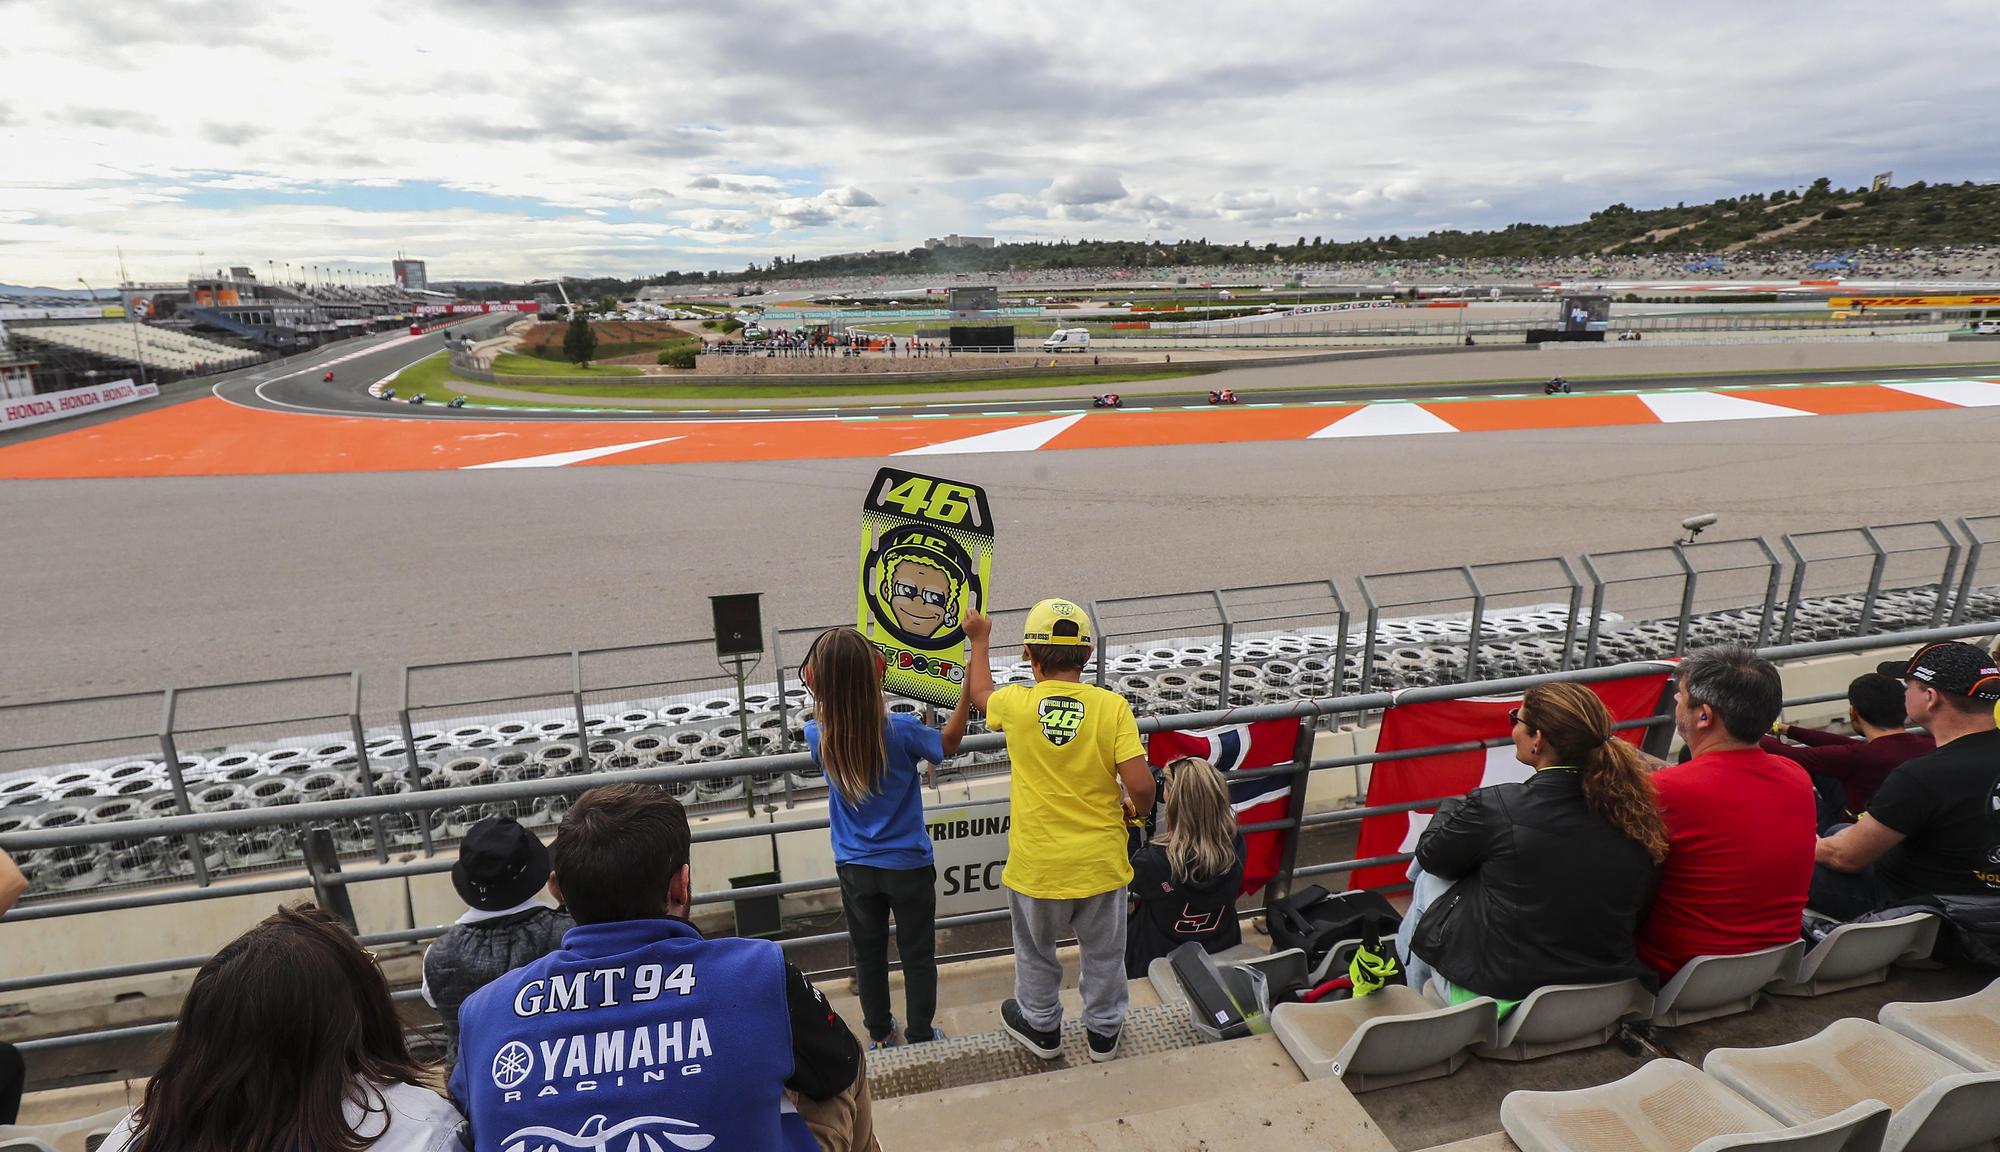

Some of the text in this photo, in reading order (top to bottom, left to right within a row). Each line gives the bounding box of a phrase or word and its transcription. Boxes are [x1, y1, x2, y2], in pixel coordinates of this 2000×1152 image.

[416, 305, 447, 313] MOTUL
[453, 305, 483, 313] MOTUL
[488, 304, 518, 312] MOTUL
[6, 385, 136, 420] HONDA HONDA HONDA
[885, 477, 976, 524] 46
[899, 650, 965, 682] DOCTO
[1040, 709, 1084, 729] 46
[943, 860, 1007, 896] SEC
[513, 963, 697, 1018] GMT 94
[539, 1017, 713, 1081] YAMAHA
[504, 1063, 702, 1103] RACING
